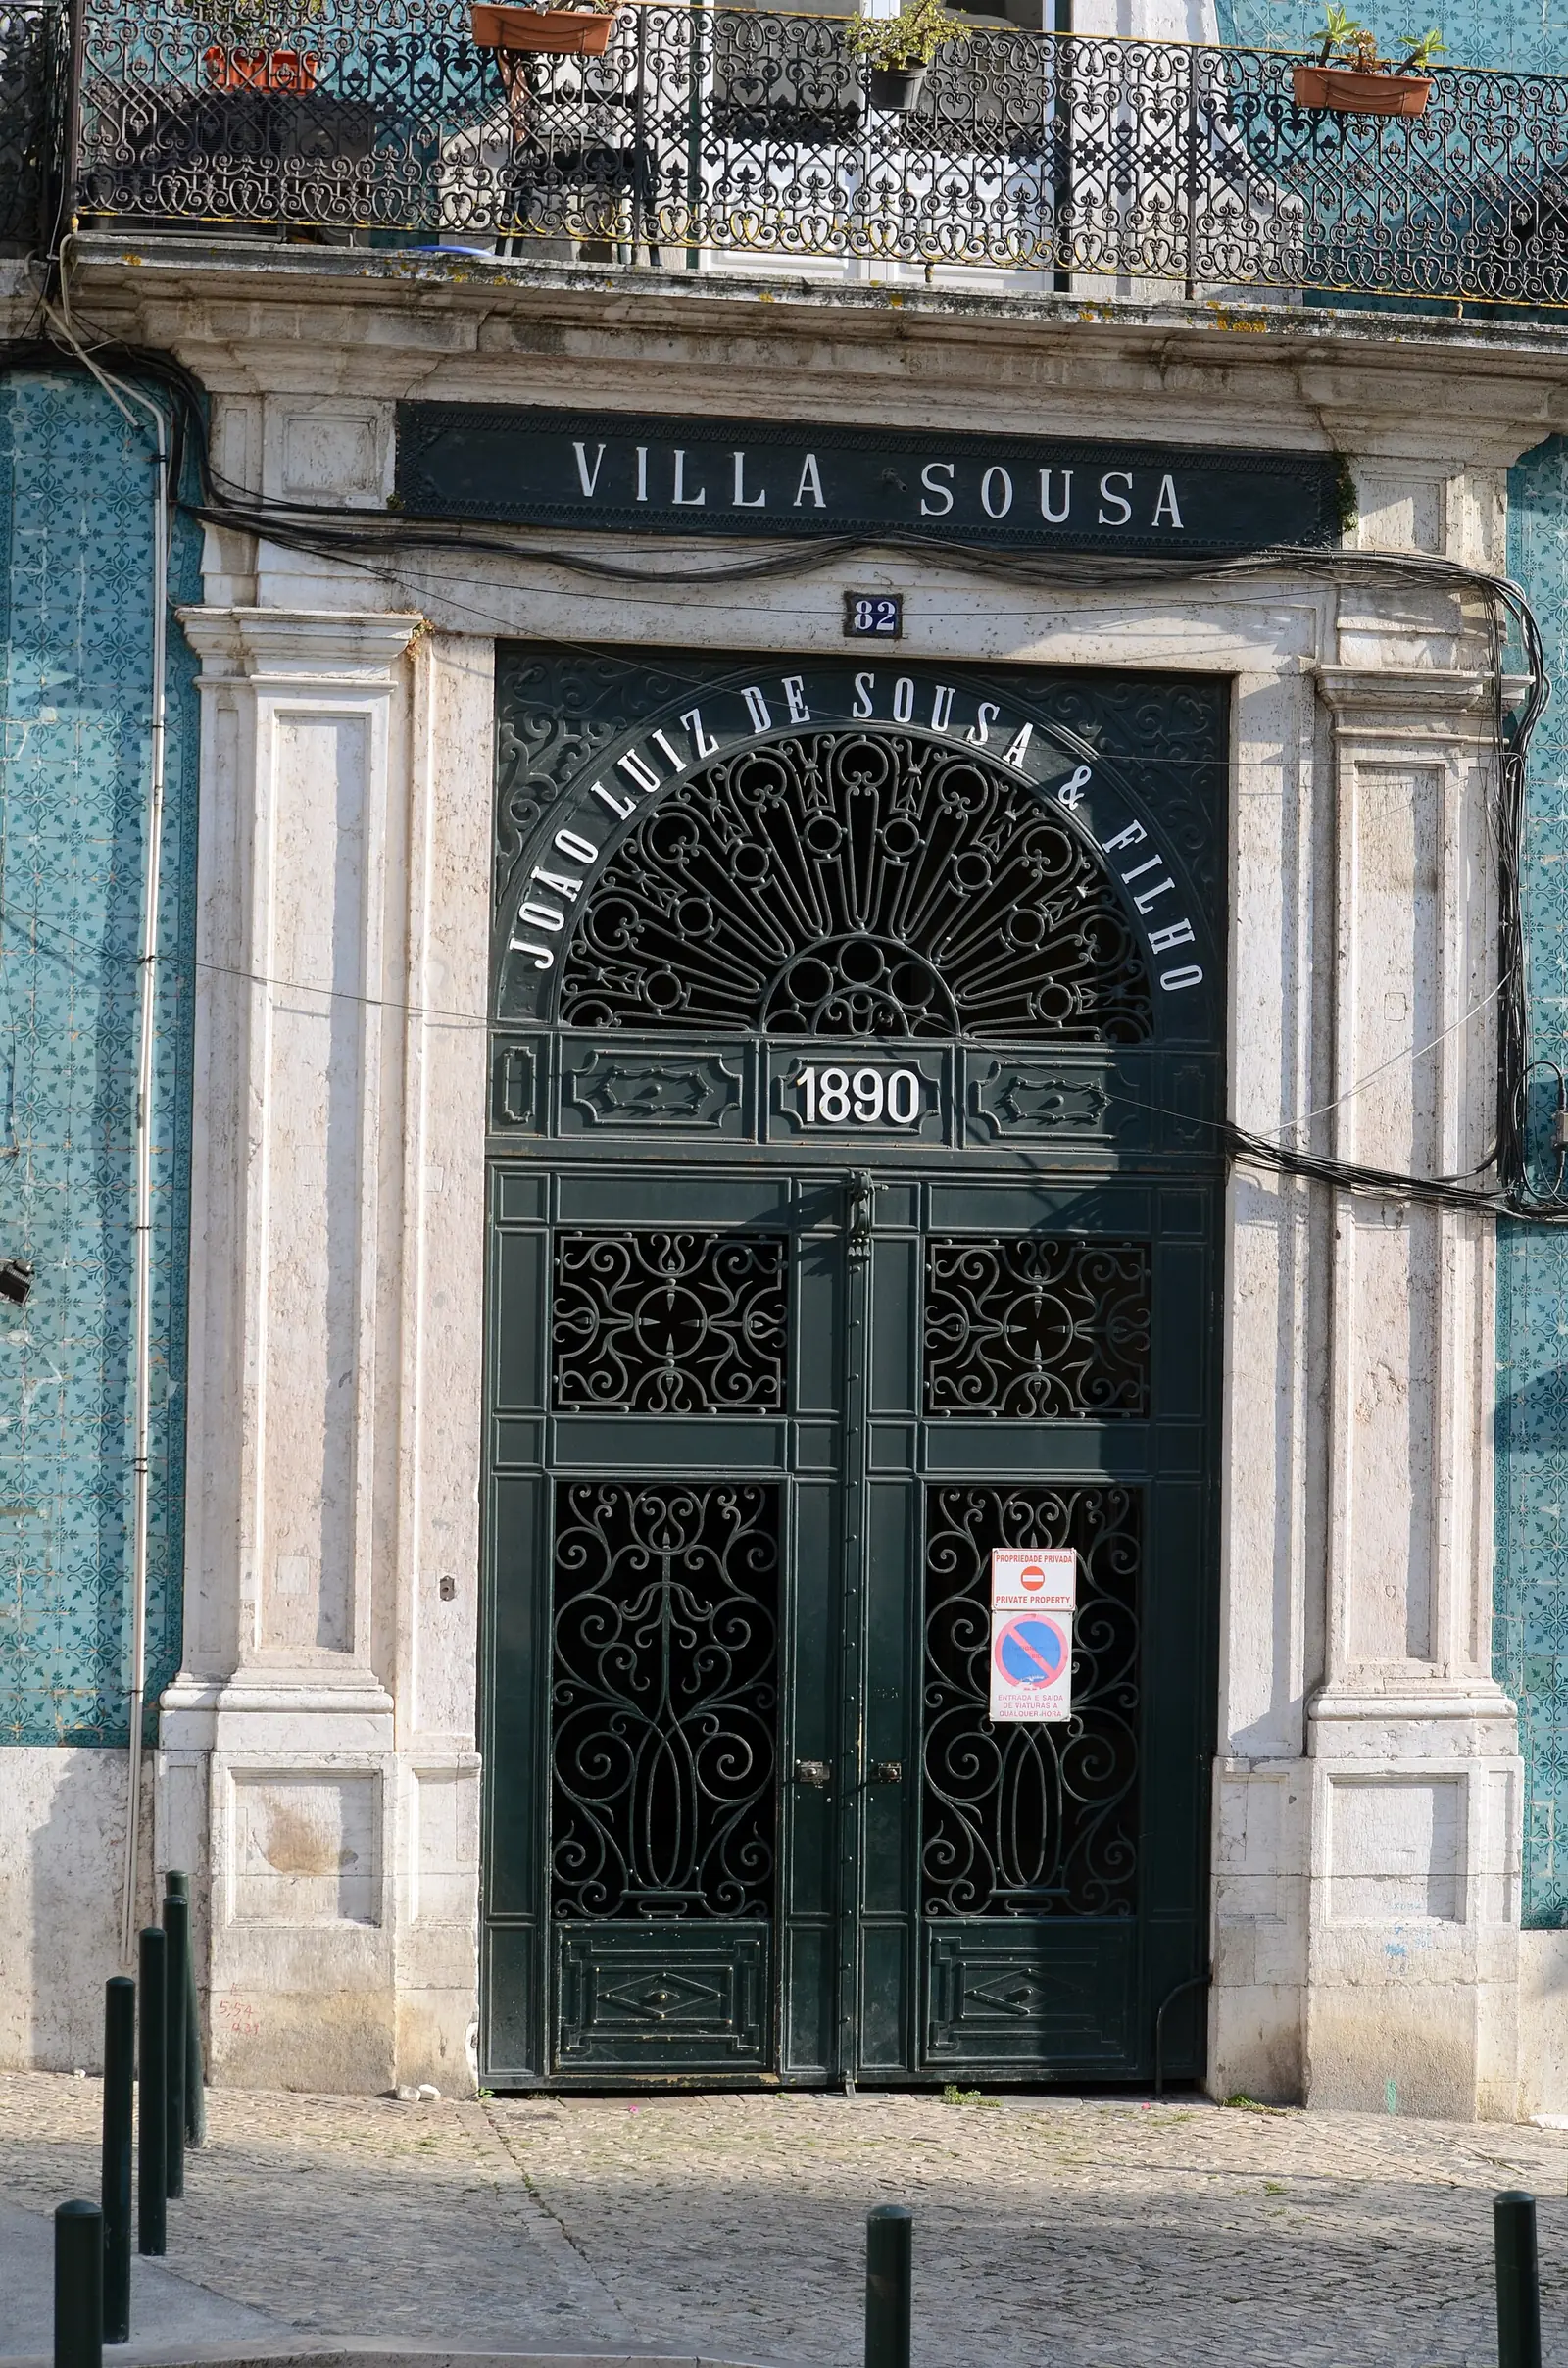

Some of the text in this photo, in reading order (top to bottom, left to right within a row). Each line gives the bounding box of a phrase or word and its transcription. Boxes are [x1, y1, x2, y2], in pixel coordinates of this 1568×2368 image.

[572, 441, 1185, 528] VILLA SOUSA
[854, 600, 896, 631] 82
[509, 672, 1203, 992] JOAO LUIZ DE SOUSA & FILHO
[796, 1066, 920, 1124] 1890
[995, 1554, 1073, 1563] PROPRIEDADE PRIVADA
[995, 1595, 1071, 1604] PRIVATE PROPERTY
